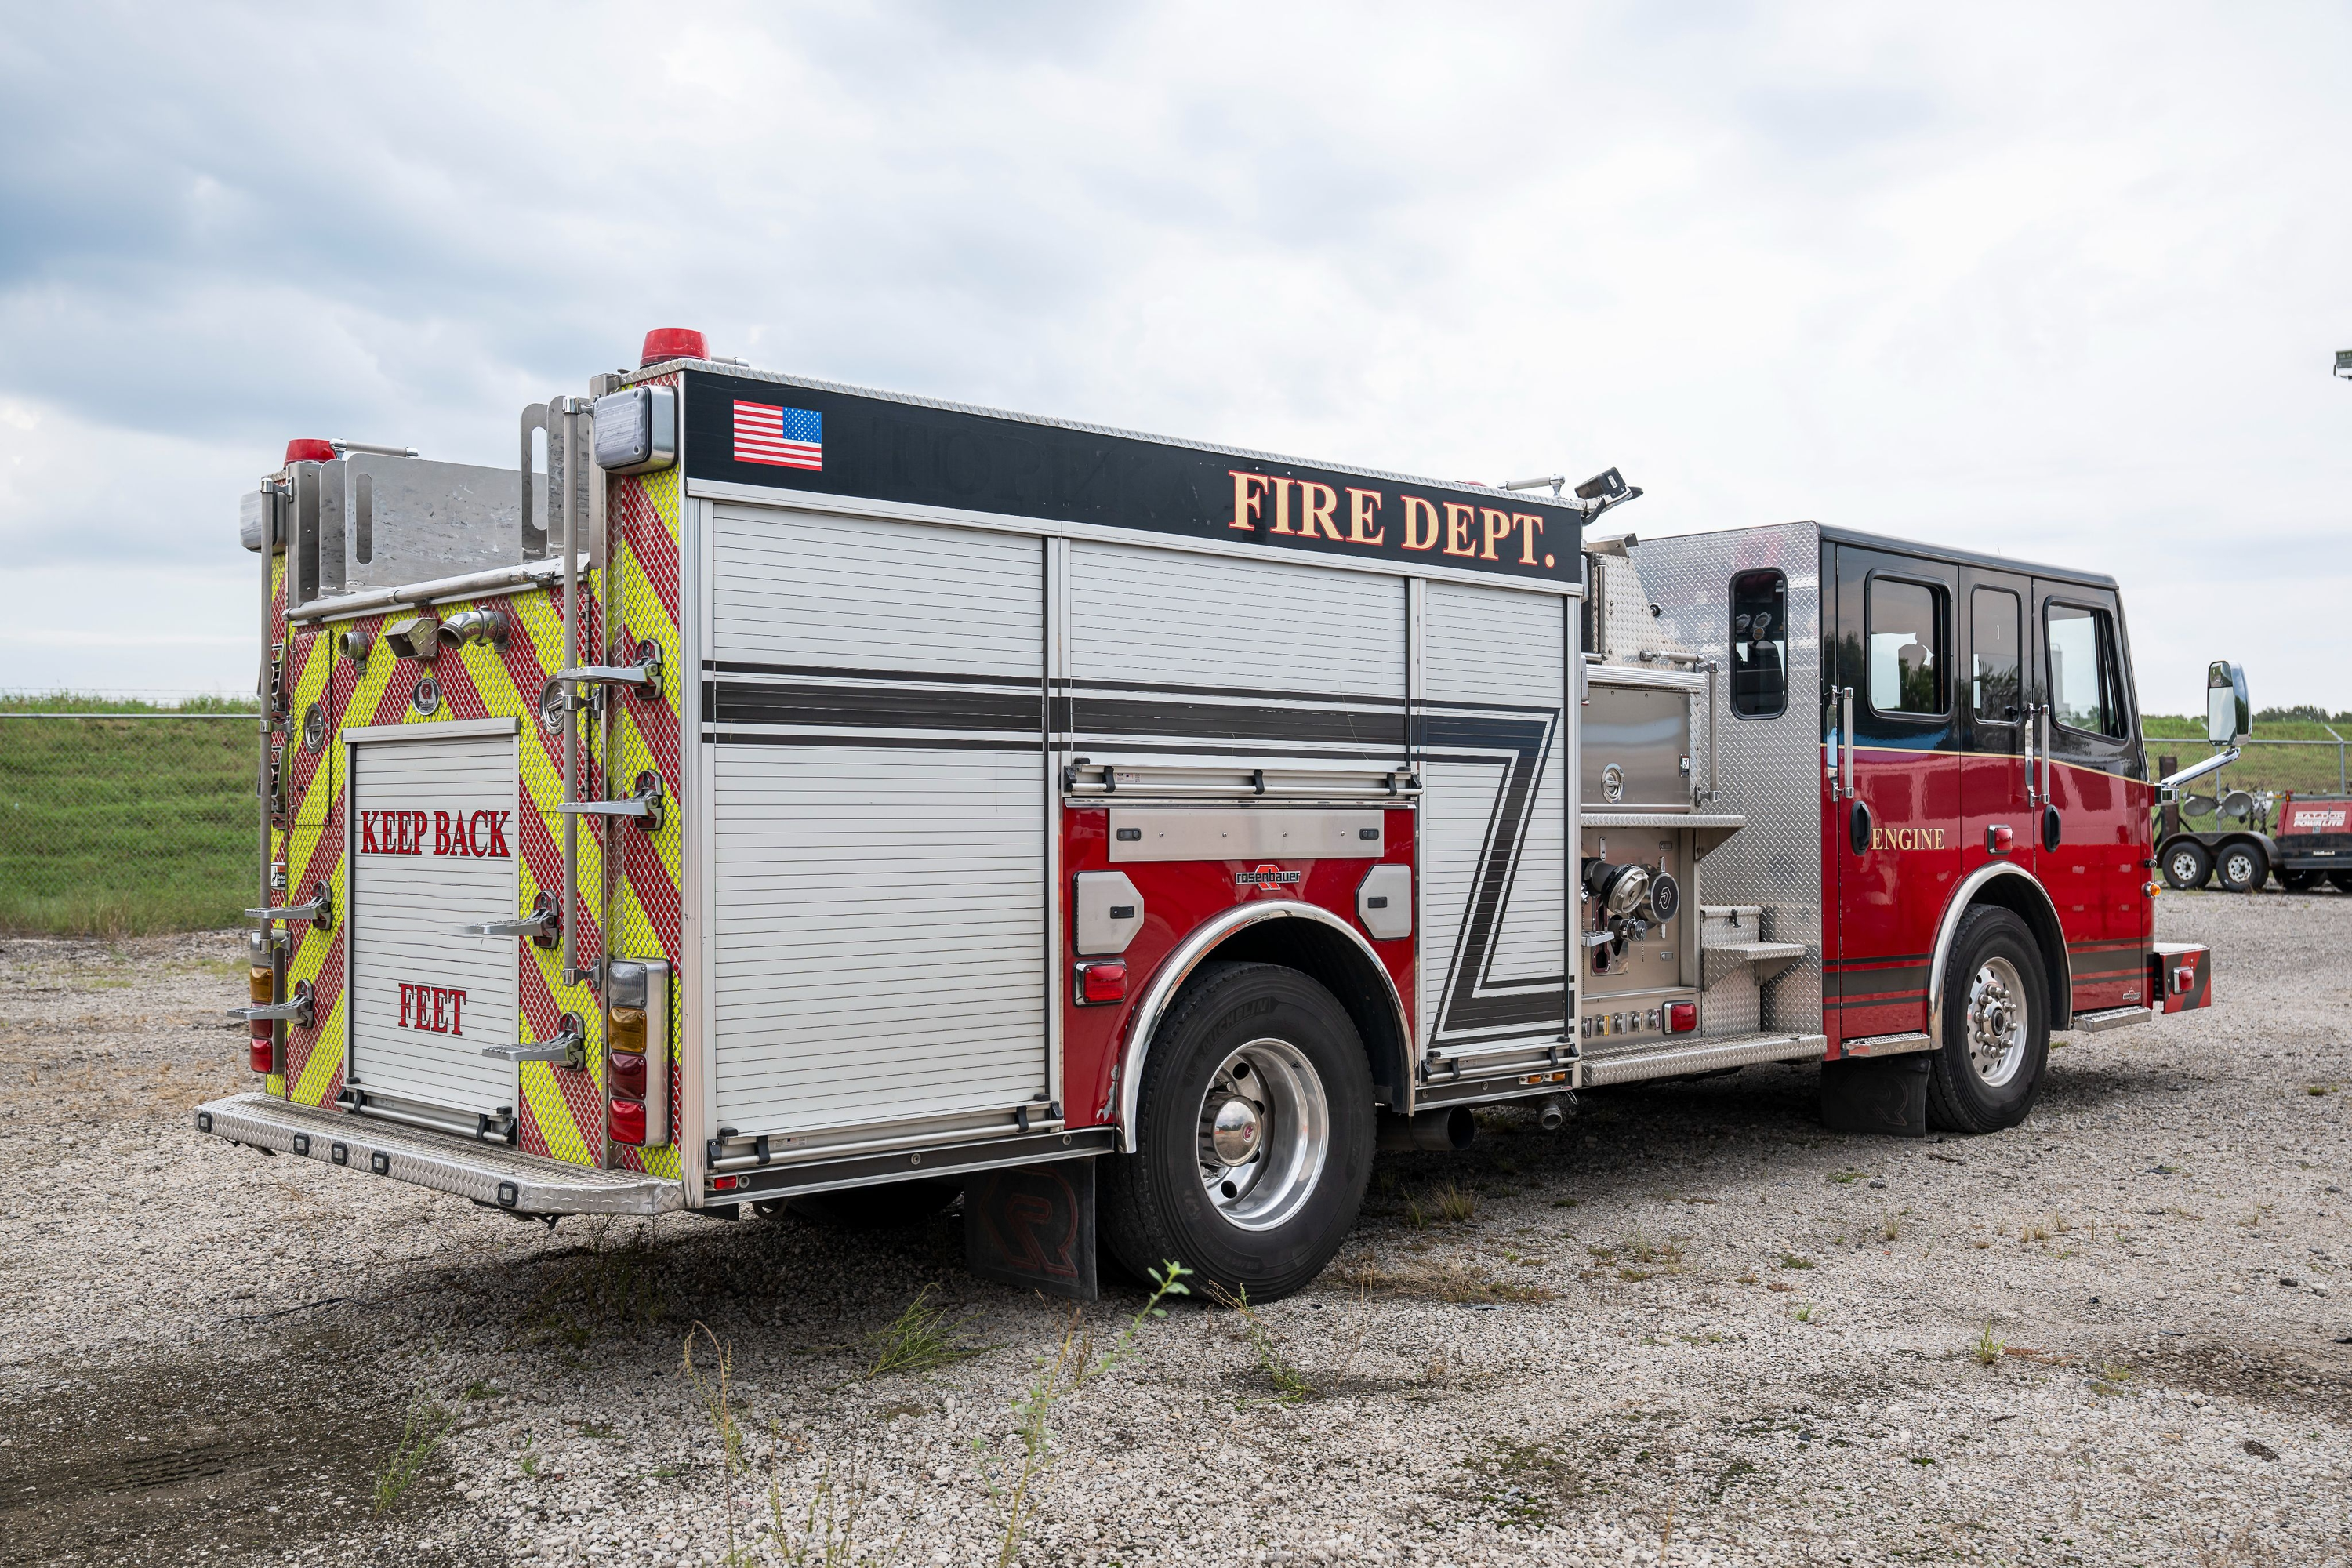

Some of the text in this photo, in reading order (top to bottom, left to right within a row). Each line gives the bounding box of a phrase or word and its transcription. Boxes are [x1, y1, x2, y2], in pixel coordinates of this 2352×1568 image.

[1228, 470, 1555, 569] FIRE DEPT.
[360, 809, 511, 858] KEEP BACK
[1871, 827, 1945, 851] ENGINE
[1236, 868, 1301, 884] rosenbauer
[398, 982, 466, 1036] FEET
[1202, 998, 1269, 1054] MICHELIN
